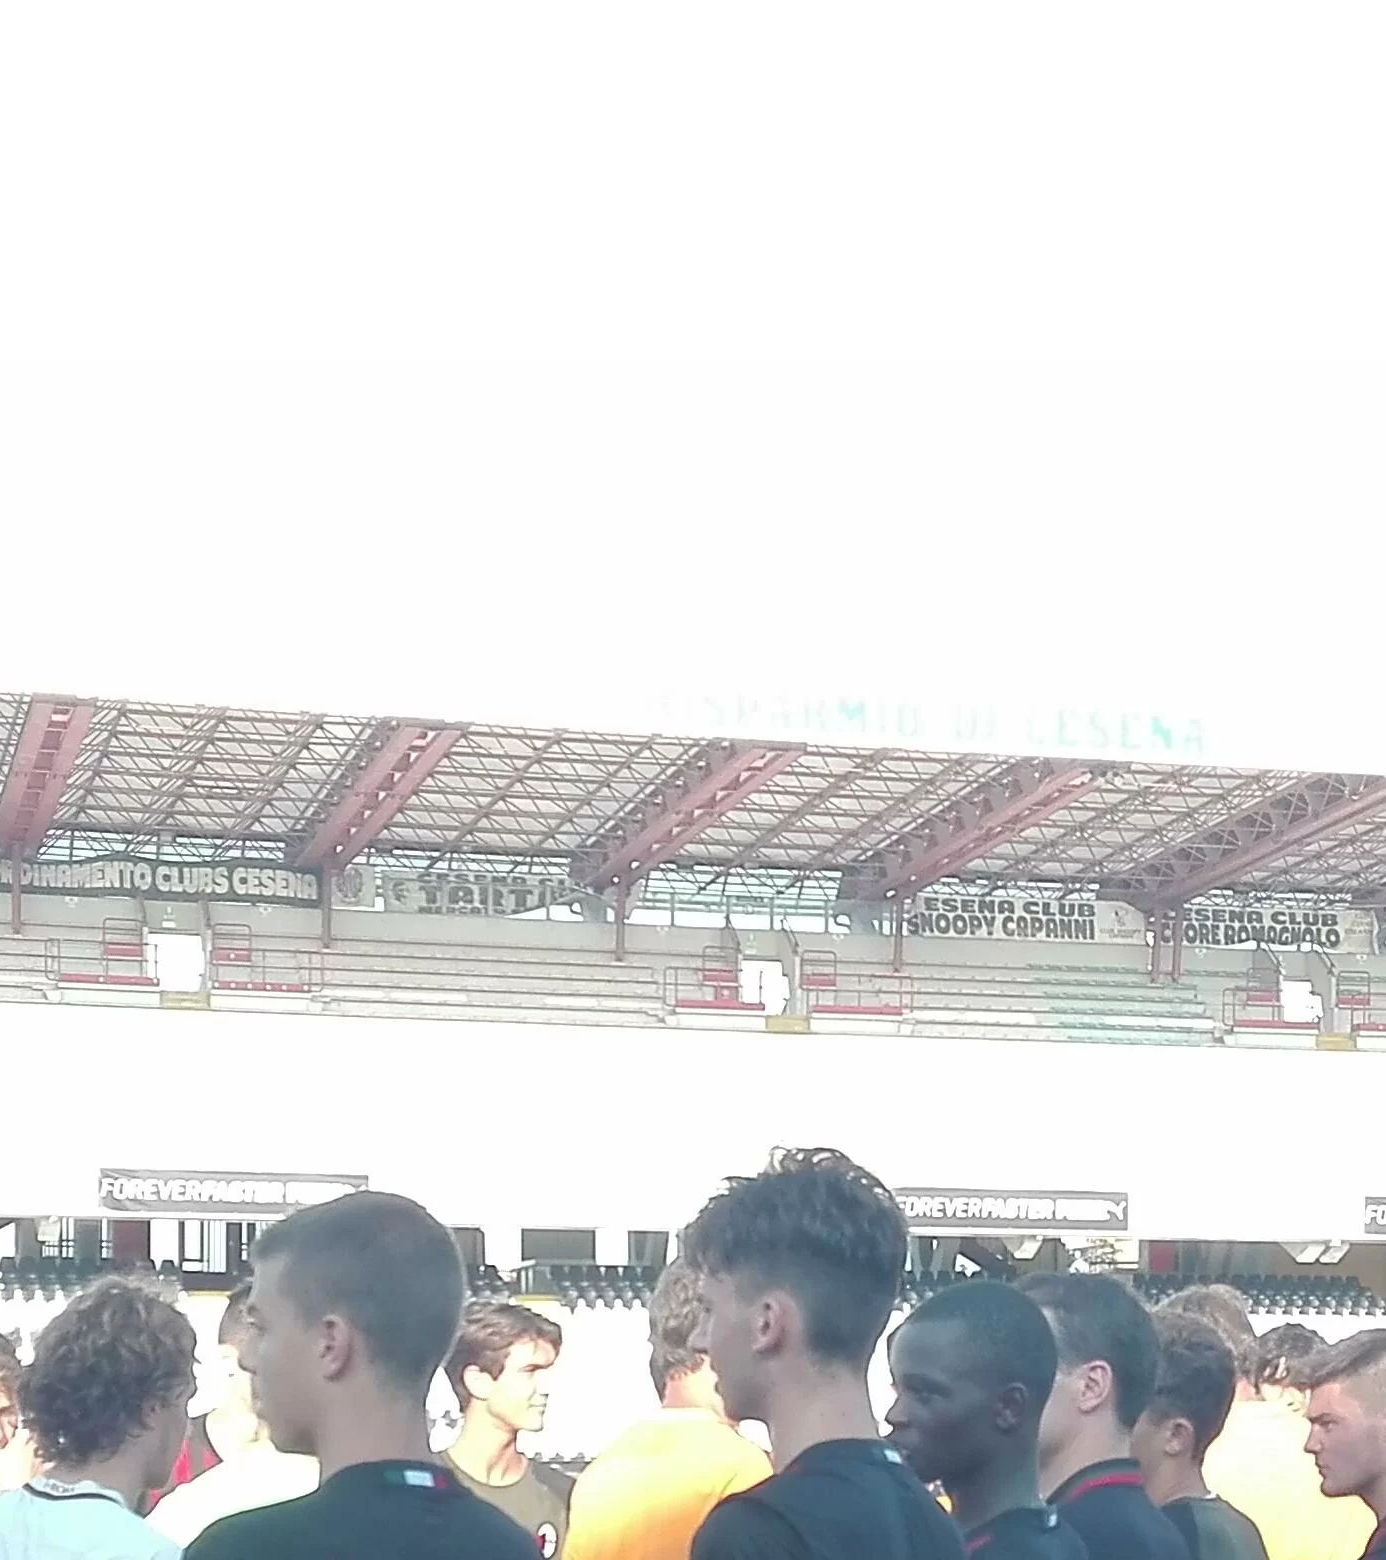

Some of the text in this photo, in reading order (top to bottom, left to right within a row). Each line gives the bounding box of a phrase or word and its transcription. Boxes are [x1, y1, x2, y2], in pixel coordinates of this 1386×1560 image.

[155, 864, 230, 894] CLUBS
[232, 866, 317, 900] CESENA
[924, 897, 1095, 917] ESENA CLUB
[1181, 907, 1263, 924] ESENA
[1270, 910, 1339, 927] CLUB
[908, 912, 996, 936] SNOOPY
[1002, 915, 1095, 940] CAPANNI
[1161, 922, 1221, 945] CORE
